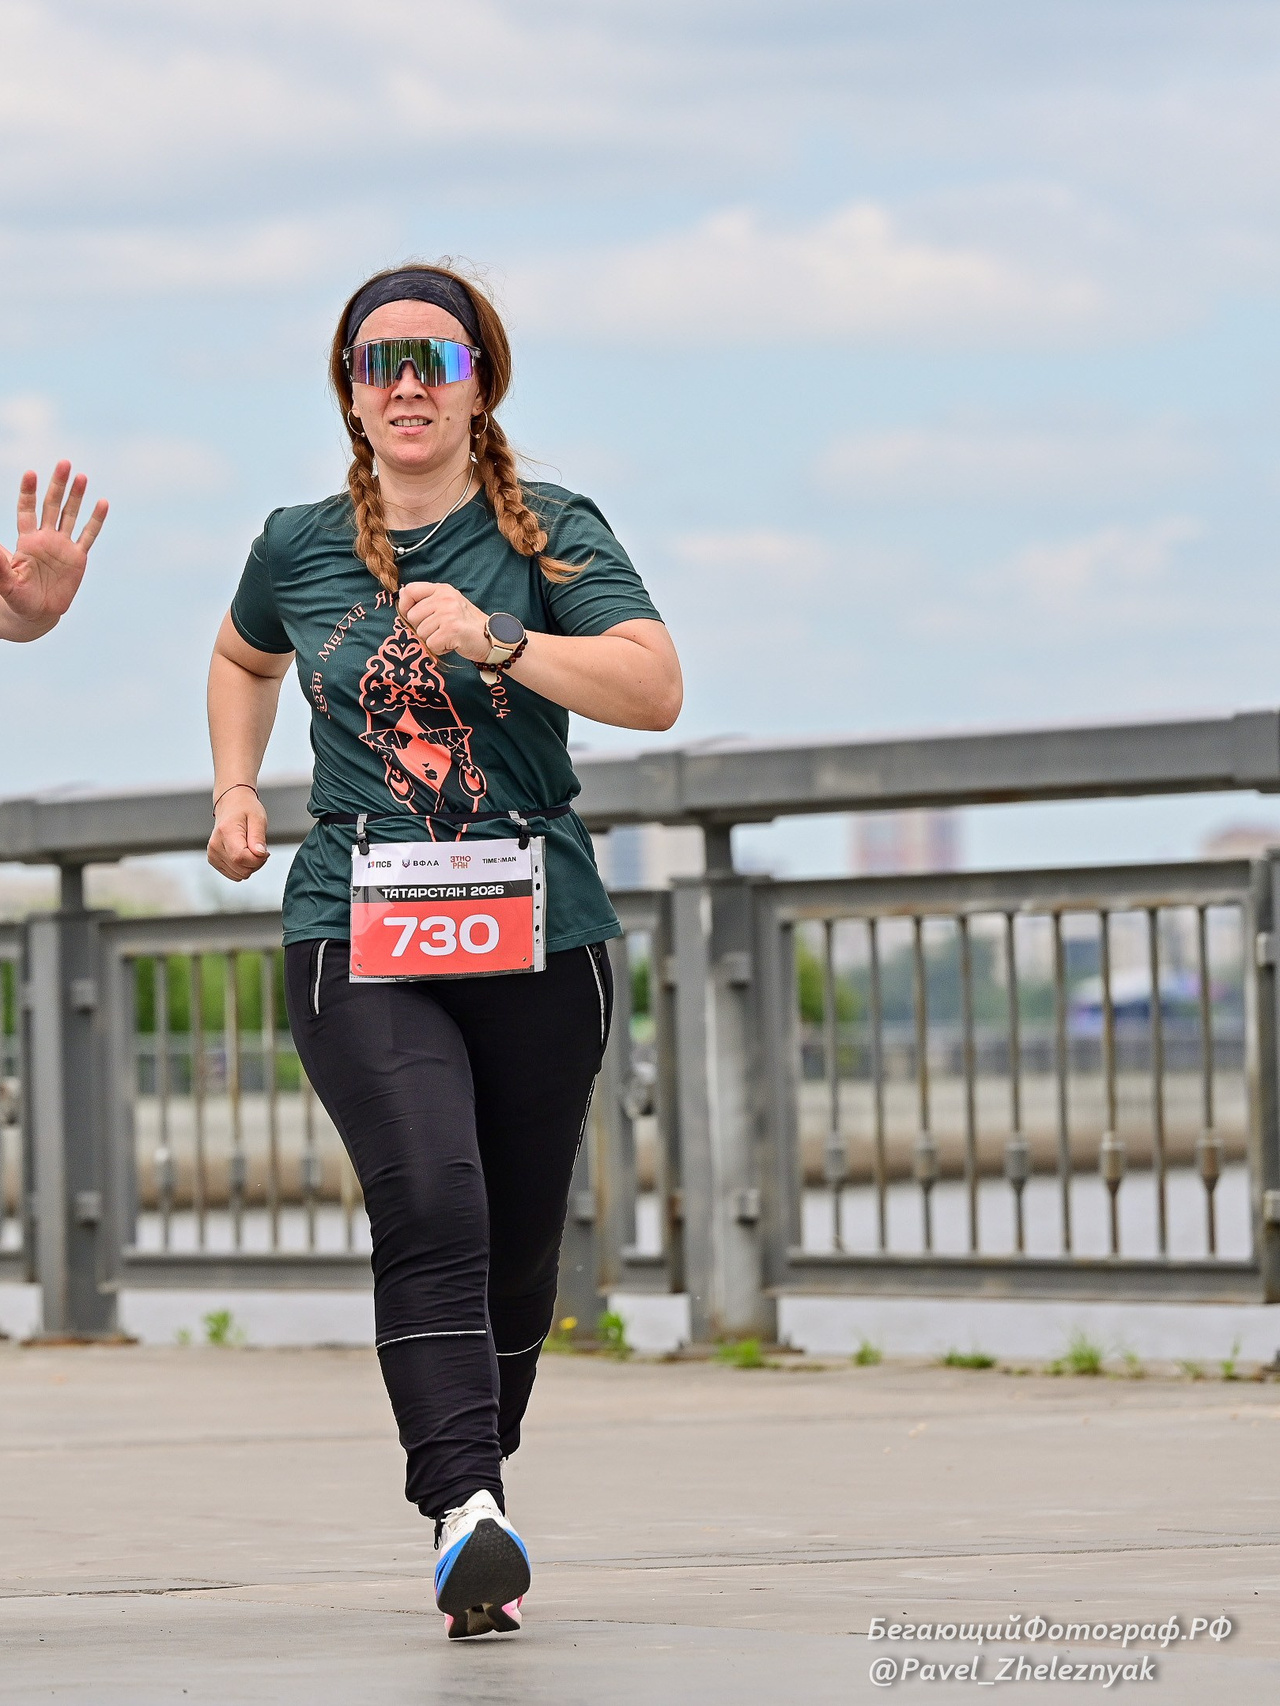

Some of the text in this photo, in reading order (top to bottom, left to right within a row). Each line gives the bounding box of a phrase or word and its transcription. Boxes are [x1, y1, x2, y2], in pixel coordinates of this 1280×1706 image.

[376, 860, 392, 868] ПСБ
[382, 885, 505, 899] ТАТАРСТАН 2026
[383, 913, 500, 957] 730
